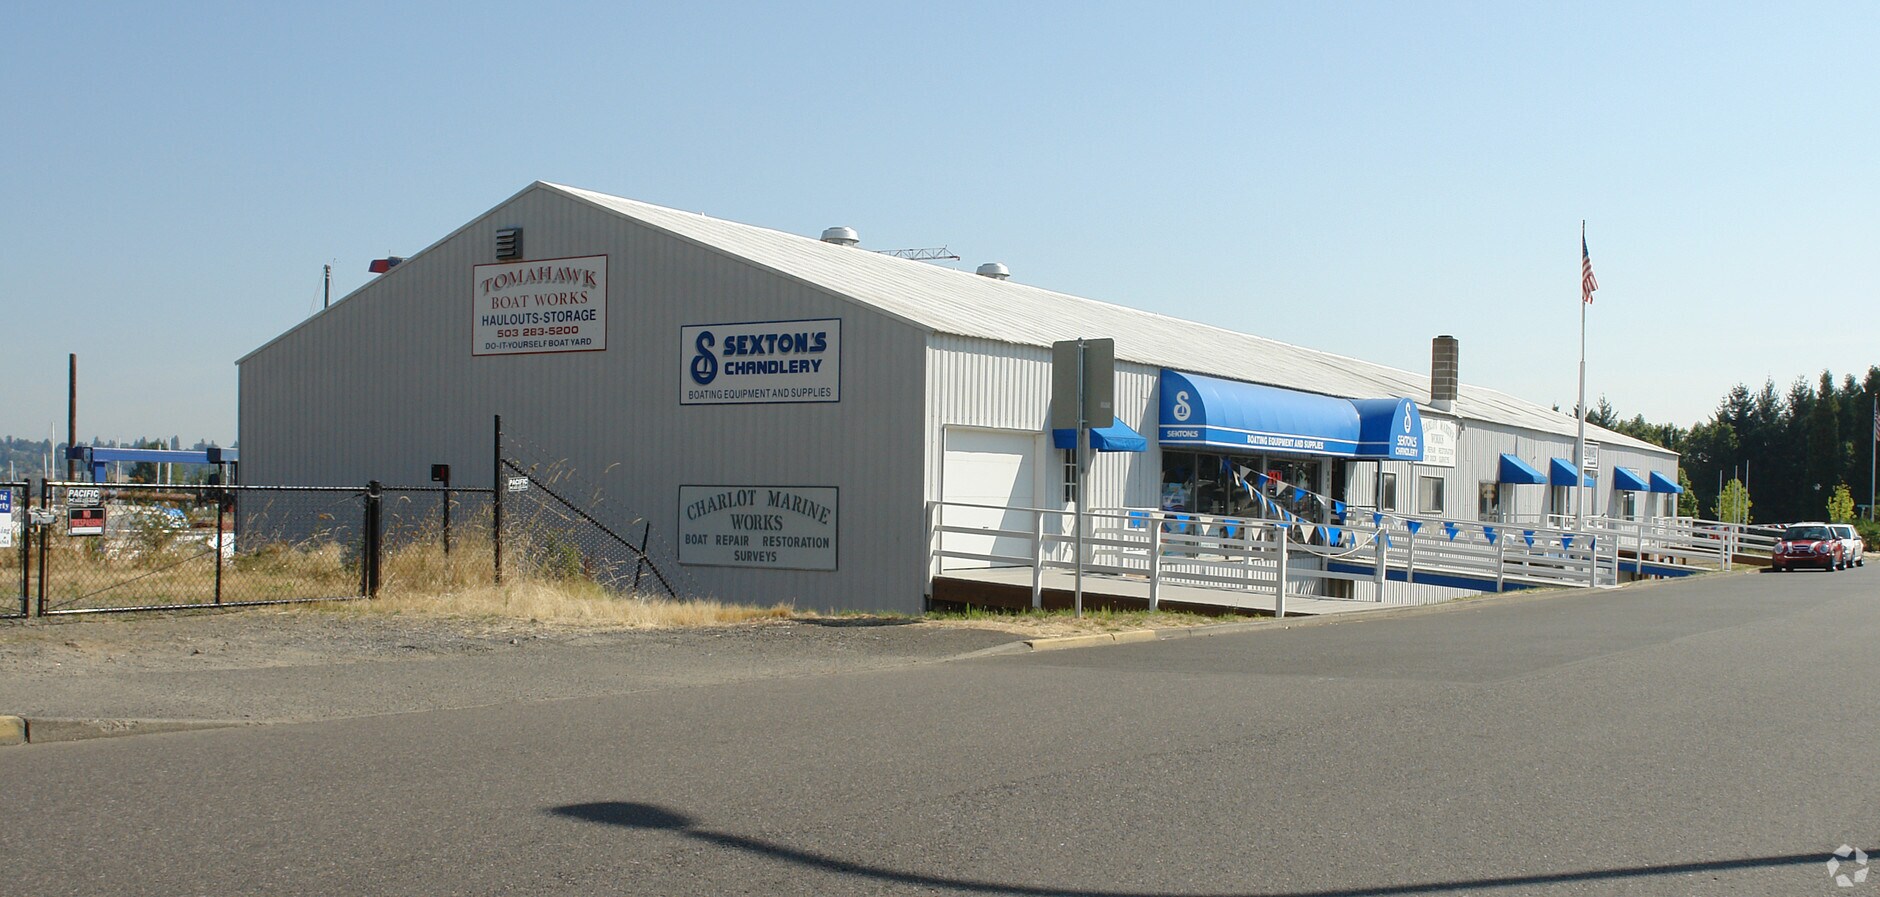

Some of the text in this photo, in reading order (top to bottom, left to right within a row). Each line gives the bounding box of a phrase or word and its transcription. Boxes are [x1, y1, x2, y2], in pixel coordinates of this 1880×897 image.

[481, 266, 597, 294] TOMAHAWK
[491, 291, 588, 309] BOAT WORKS
[482, 309, 596, 326] HAULOUTS-STORAGE
[497, 326, 579, 338] 503 283-5200
[485, 338, 592, 350] DO-IT-YOURSELF BOAT YARD
[723, 332, 827, 355] SEXTON'S
[724, 359, 823, 375] CHANDLERY
[688, 387, 831, 400] BOATING EQUIPMENT AND SUPPLIES
[1247, 434, 1324, 450] BOATING EQUIPMENT AND SUPPLIES
[68, 489, 99, 497] PACIFIC
[83, 510, 91, 518] NO
[687, 489, 831, 525] CHARLOT MARINE
[730, 514, 783, 531] WORKS
[685, 534, 830, 549] BOAT REPAIR RESTORATION
[734, 550, 777, 562] SURVEYS
